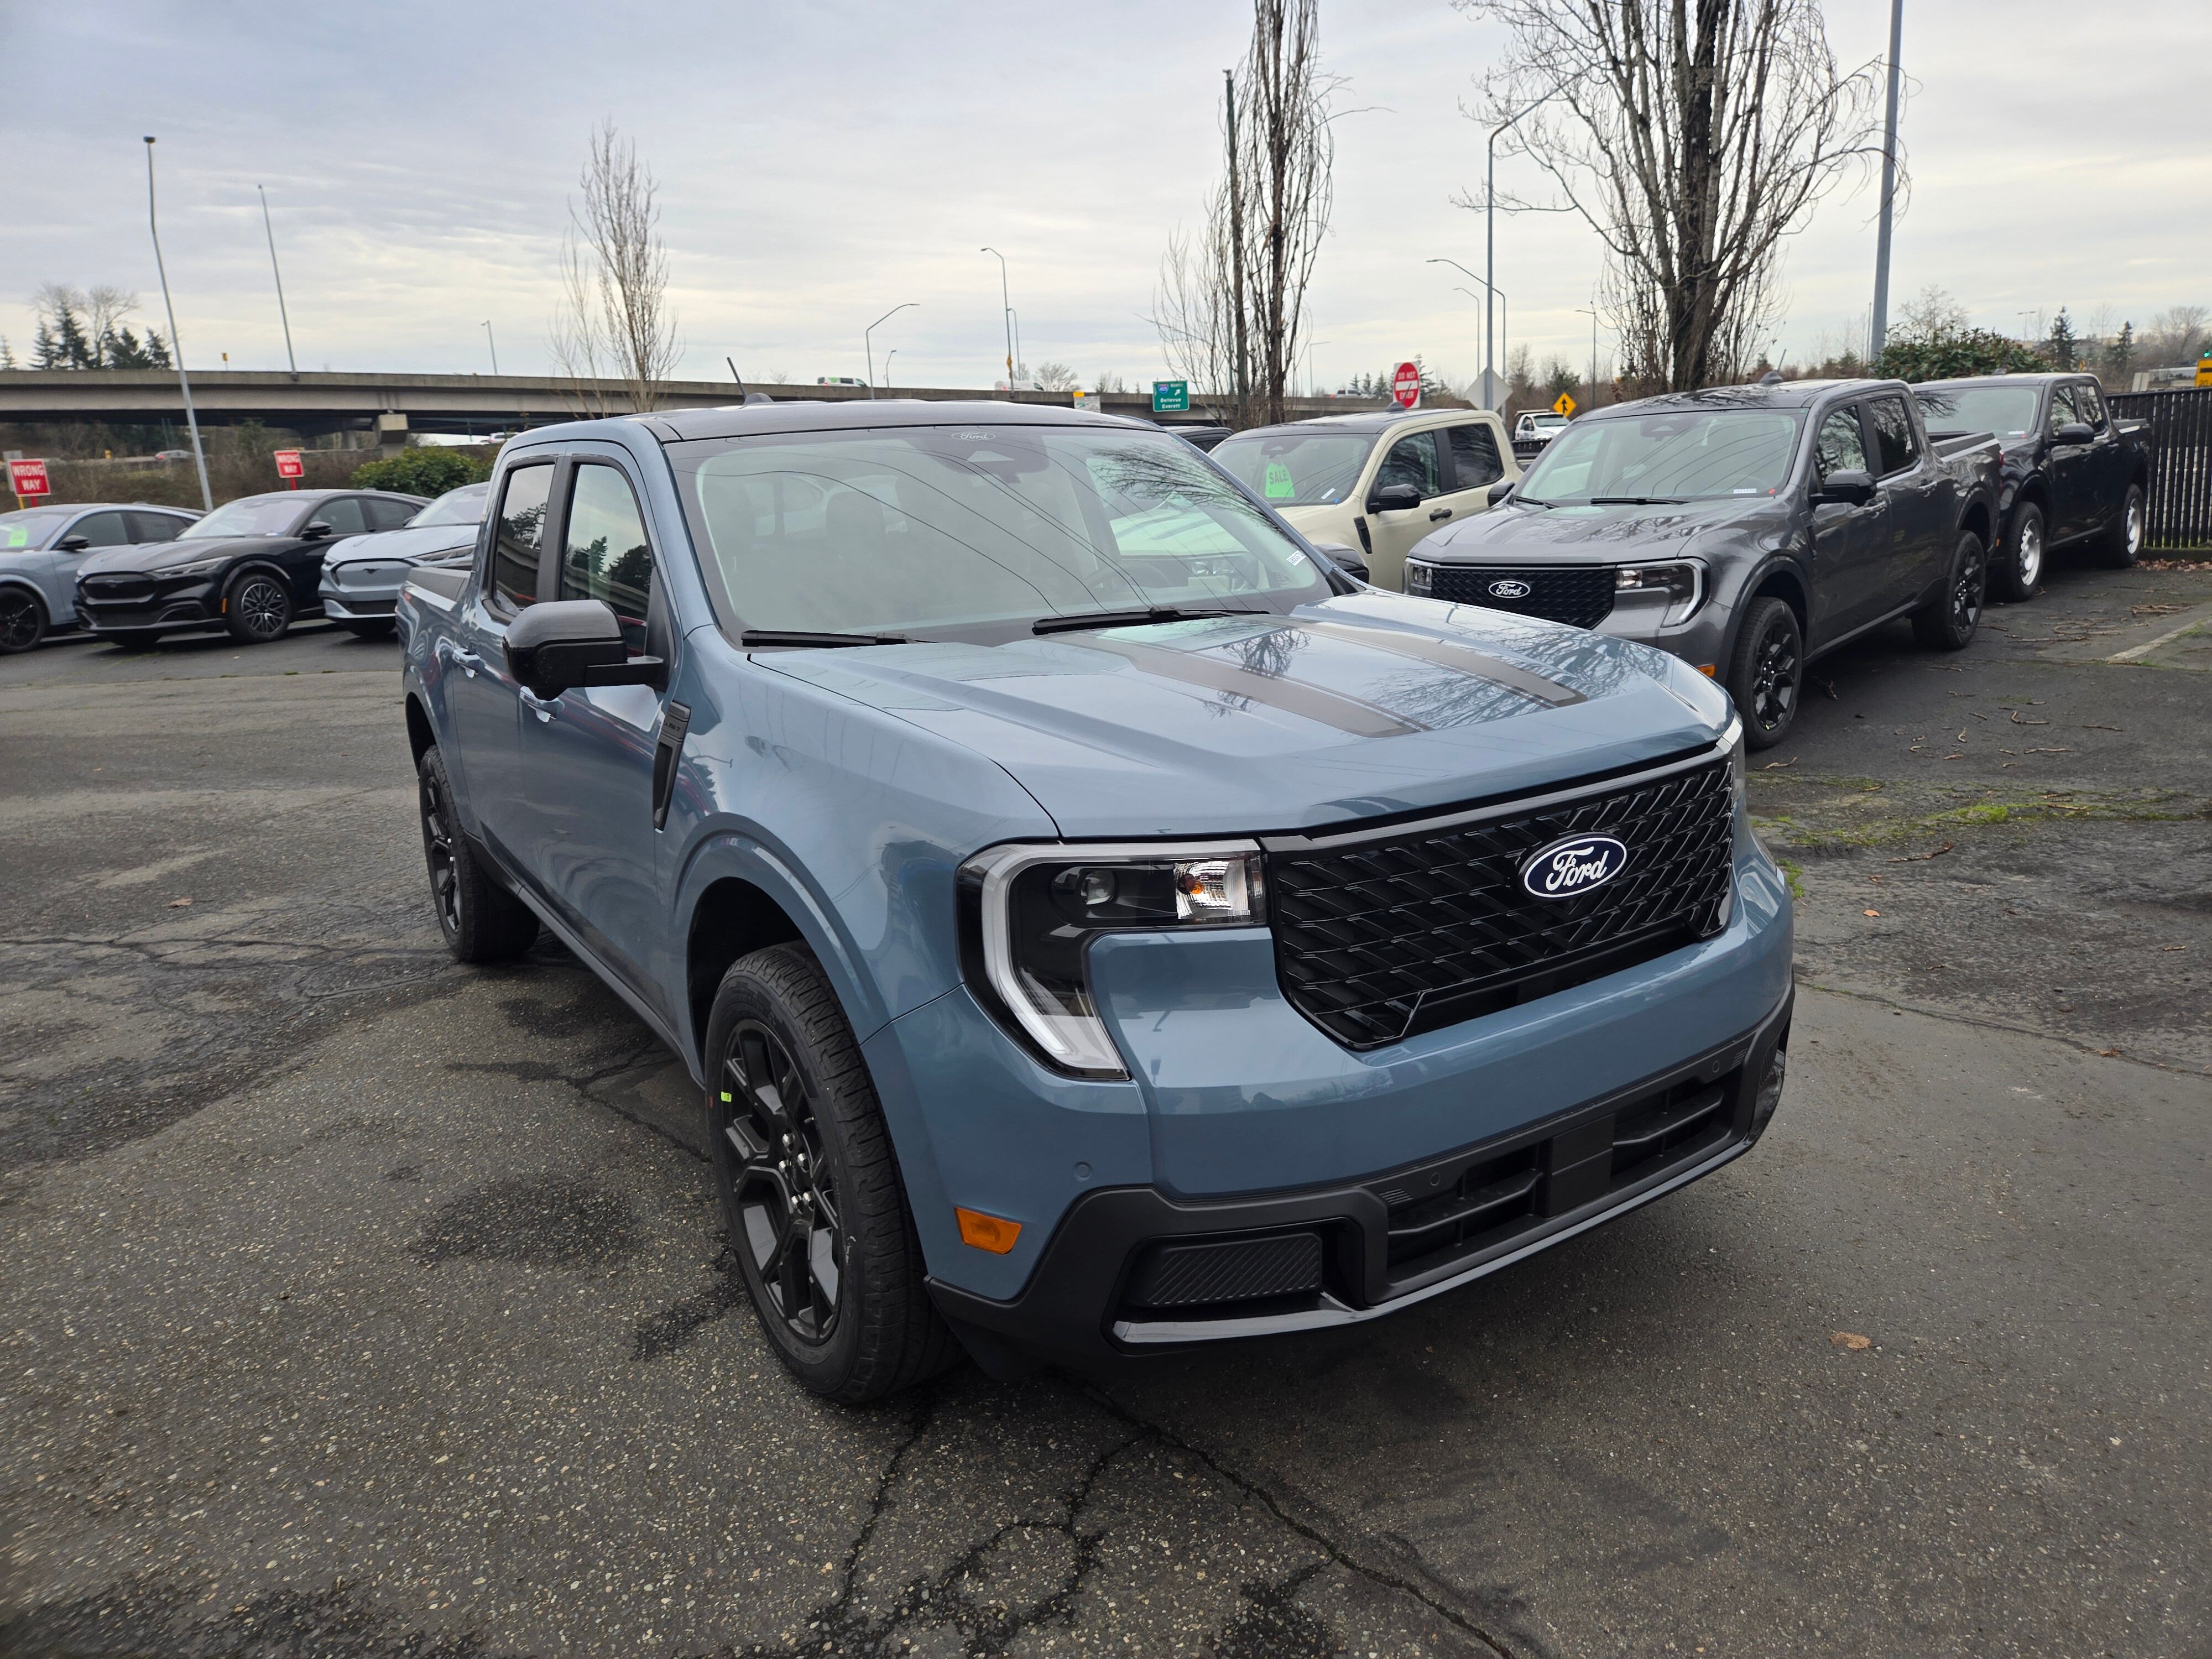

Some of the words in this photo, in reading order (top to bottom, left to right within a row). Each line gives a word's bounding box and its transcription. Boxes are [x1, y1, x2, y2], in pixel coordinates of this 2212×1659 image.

[1406, 371, 1416, 379] NOT
[277, 455, 299, 463] WRONG
[12, 464, 45, 477] WRONG
[283, 465, 298, 473] WAY
[1269, 469, 1288, 485] SALE
[22, 479, 40, 491] WAY
[1496, 583, 1522, 595] Ford
[1546, 846, 1609, 891] Ford
